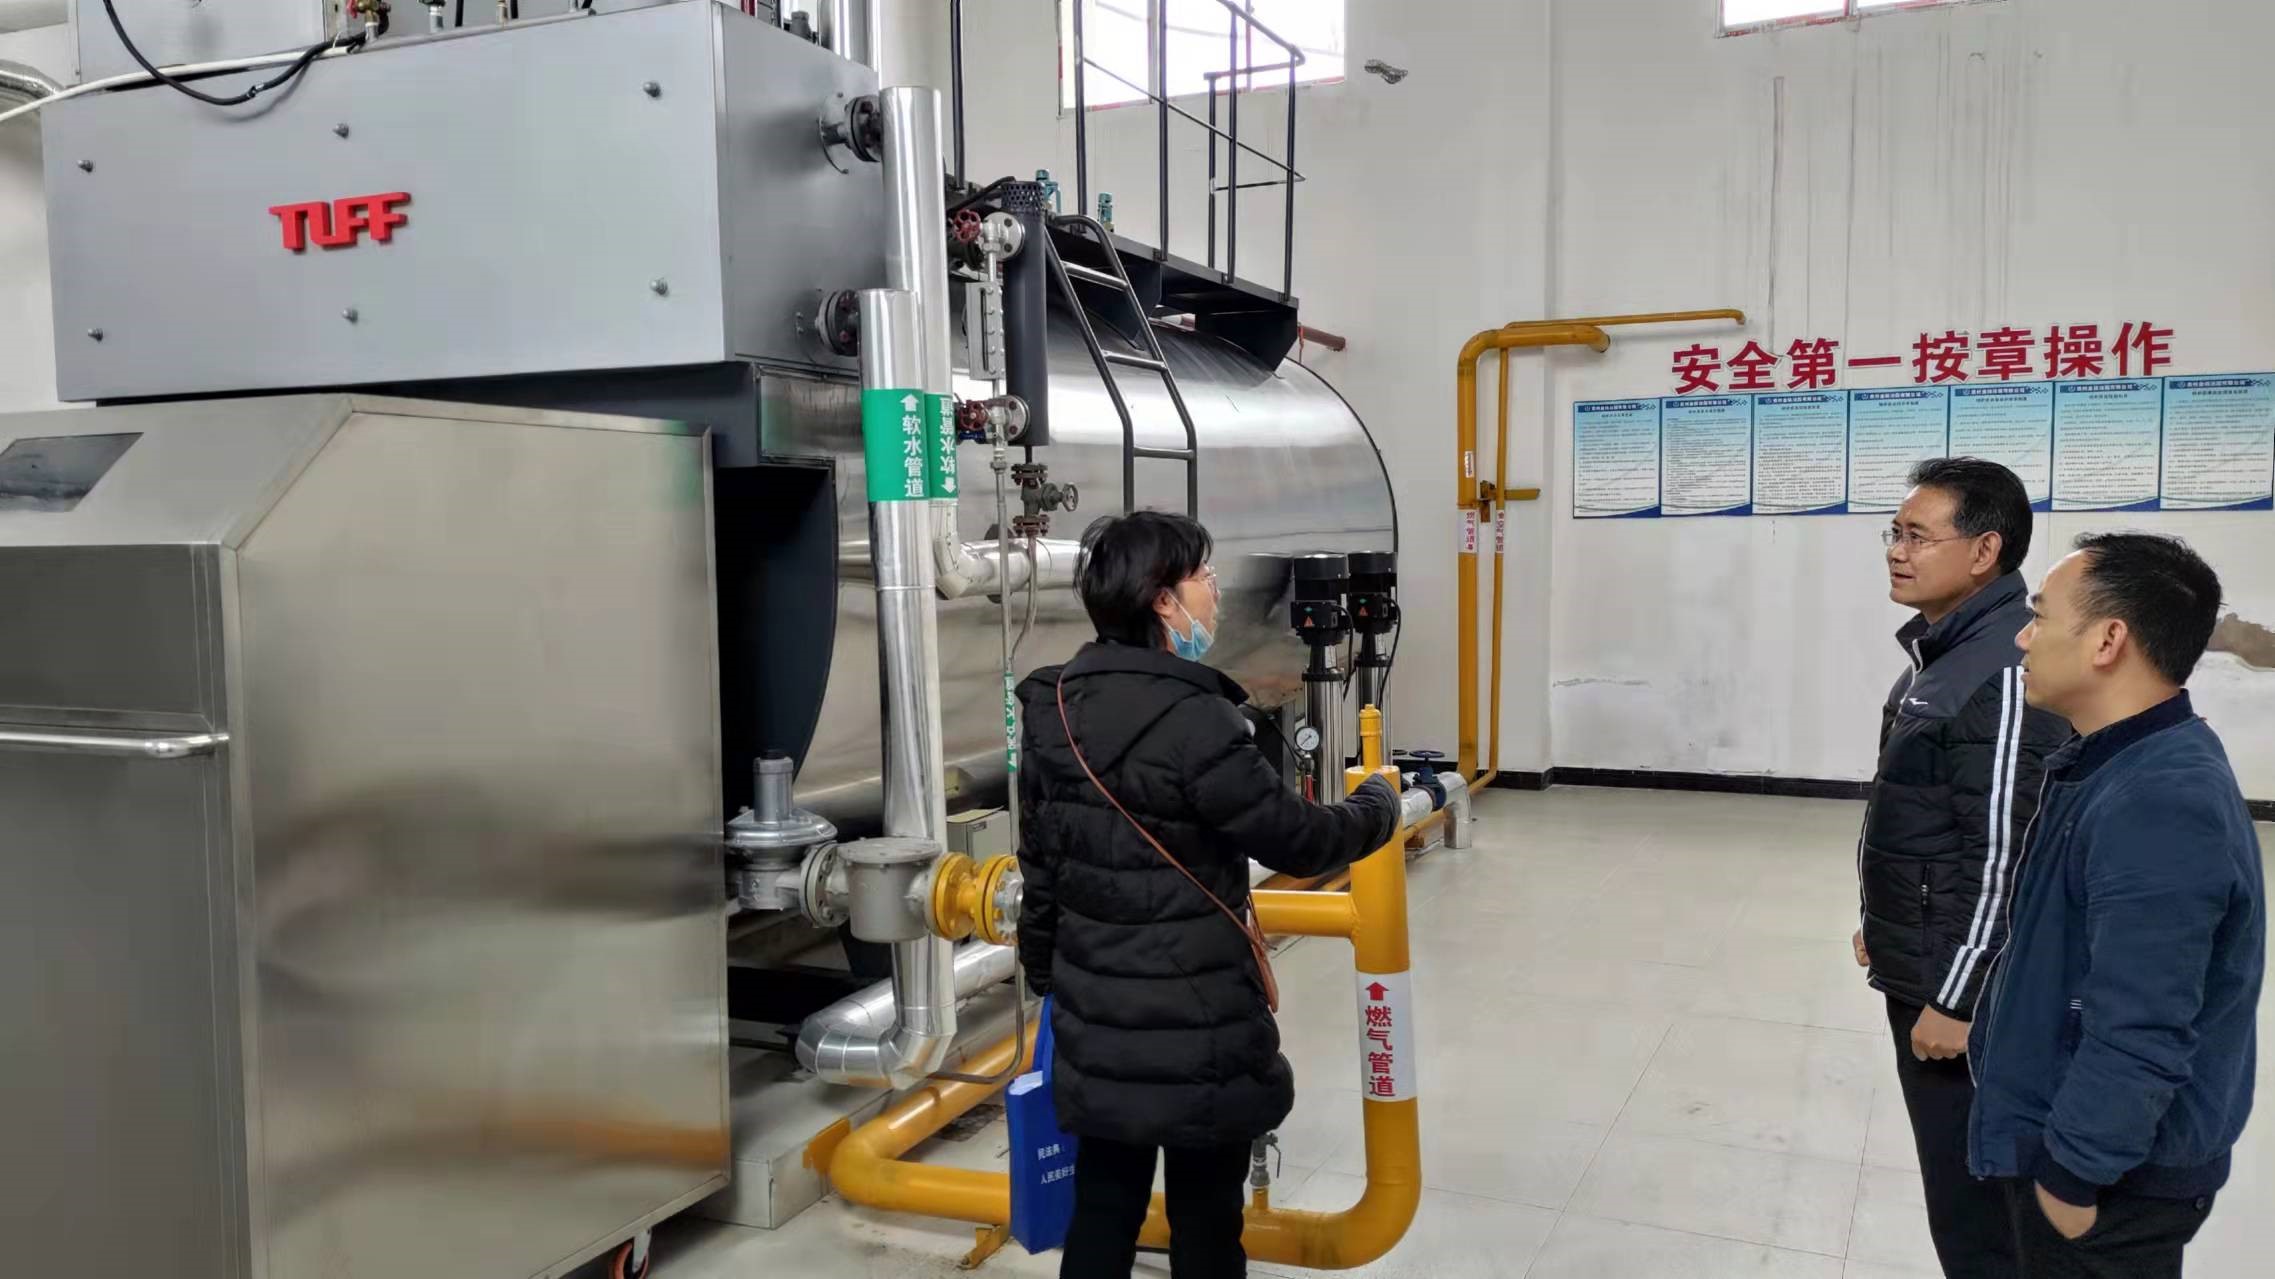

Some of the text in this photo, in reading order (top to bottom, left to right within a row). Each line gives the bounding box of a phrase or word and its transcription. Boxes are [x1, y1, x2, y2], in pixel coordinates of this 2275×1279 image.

[268, 191, 412, 254] TUFF
[1672, 321, 2173, 394] 安全第一按章操作
[902, 415, 924, 497] 软水管道
[1365, 1005, 1396, 1097] 燃气管道
